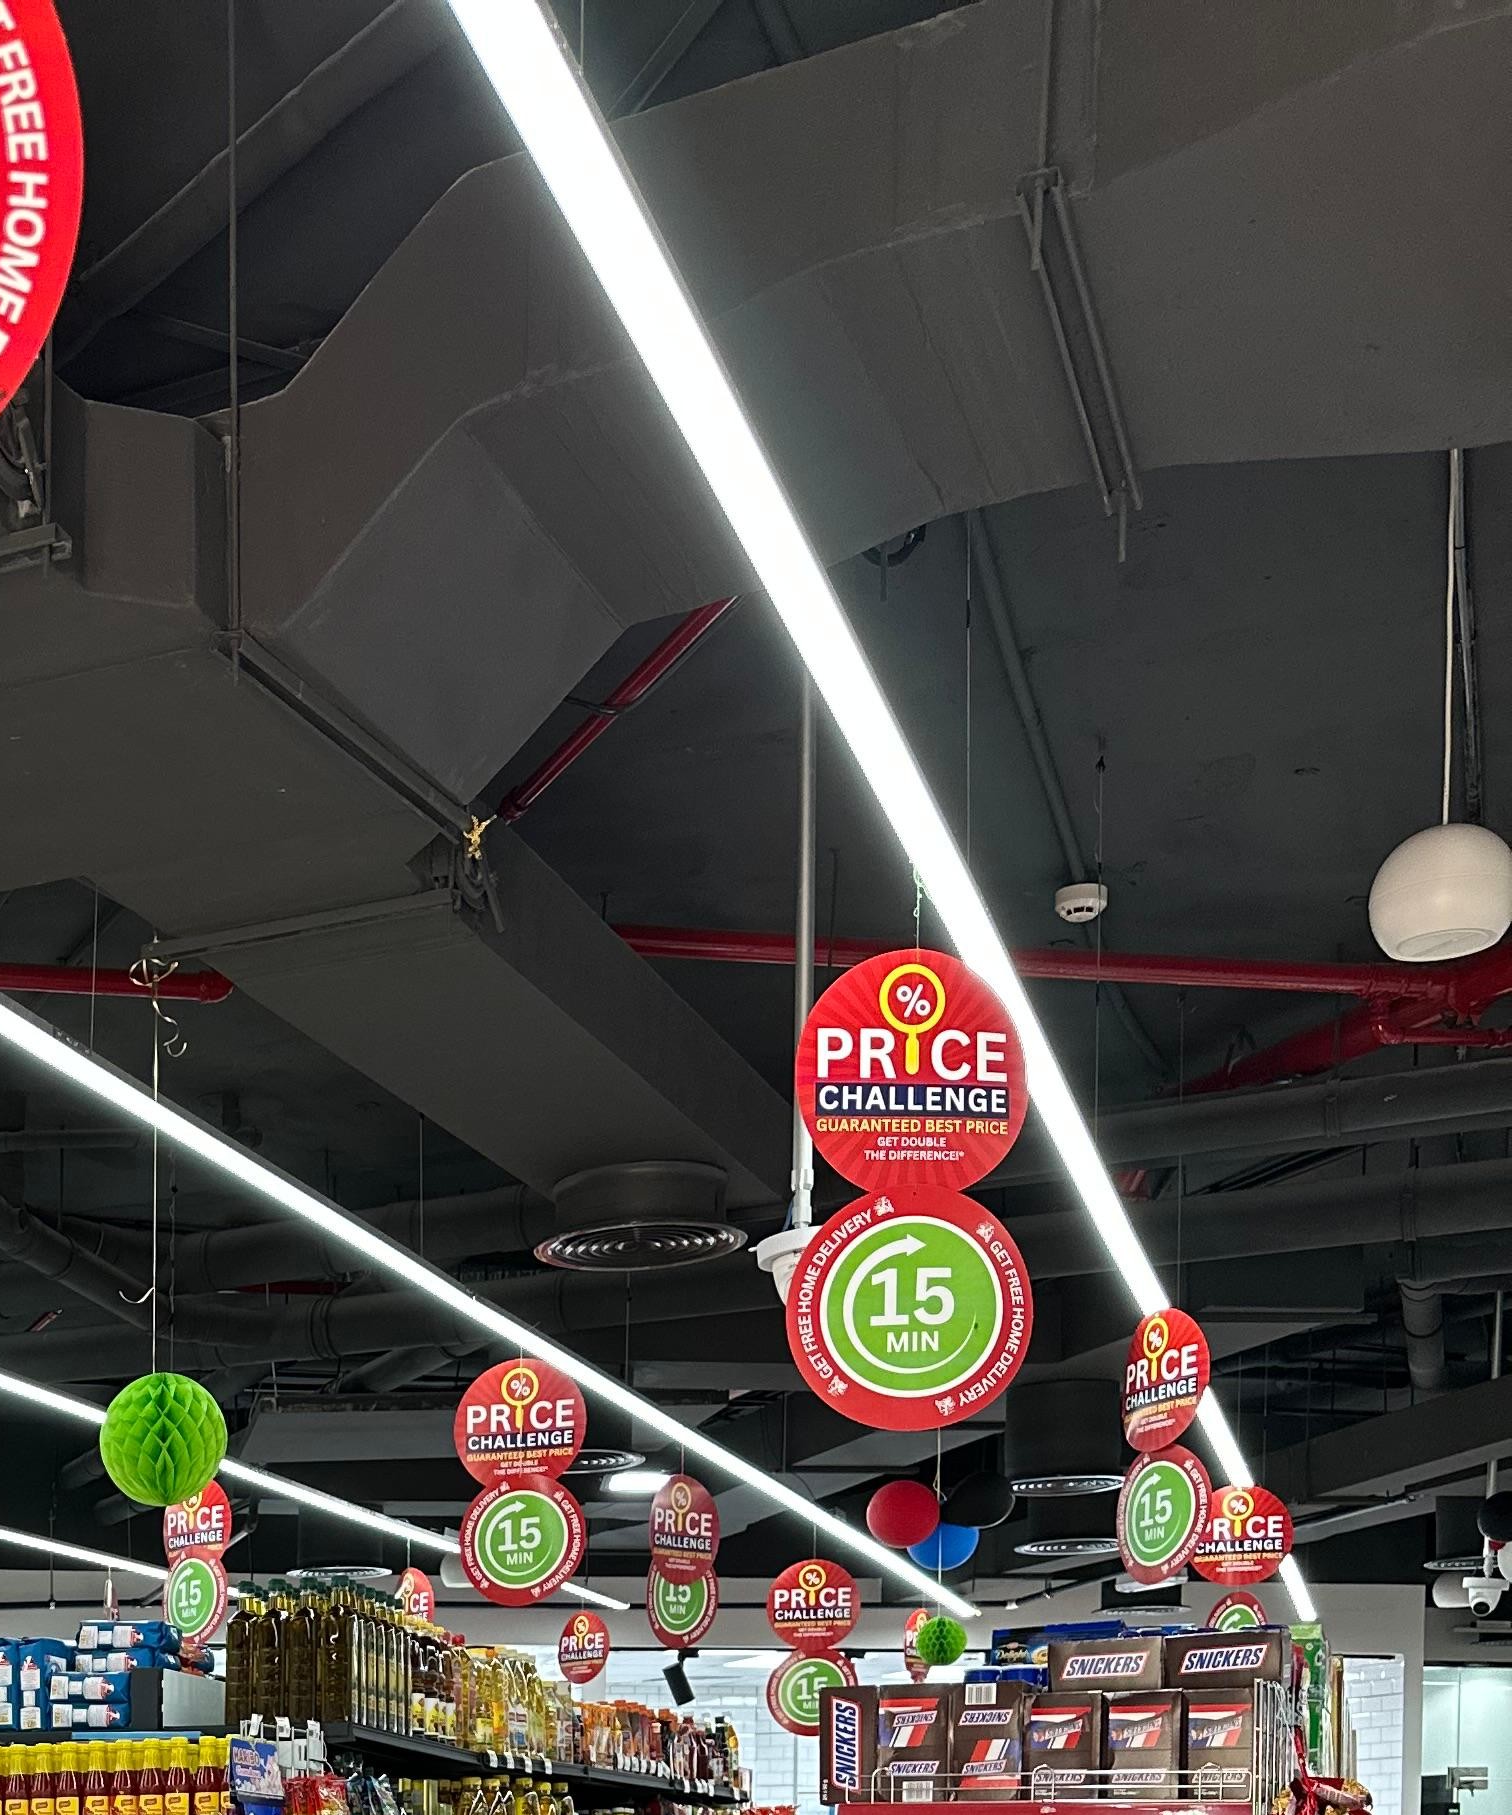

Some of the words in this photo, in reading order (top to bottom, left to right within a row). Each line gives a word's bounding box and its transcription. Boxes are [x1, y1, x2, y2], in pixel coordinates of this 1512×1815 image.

[816, 1028, 1009, 1083] PRICE
[819, 1085, 1008, 1114] CHALLENGE
[816, 1118, 923, 1133] GUARANTEED
[925, 1120, 962, 1134] BEST
[966, 1121, 1009, 1135] PRICE
[877, 1137, 898, 1148] GET
[900, 1137, 947, 1148] DOUBLE
[864, 1150, 886, 1161] THE
[813, 1208, 873, 1266] DELIVERY
[990, 1240, 1013, 1267] GET
[798, 1265, 821, 1313] HOME
[869, 1267, 954, 1326] 15
[1005, 1268, 1024, 1305] FREE
[798, 1315, 818, 1353] FREE
[886, 1331, 939, 1352] MIN
[1005, 1308, 1024, 1354] HOME
[808, 1354, 833, 1379] GET
[1126, 1344, 1199, 1394] PRICE
[959, 1356, 1013, 1407] DELIVERY
[1126, 1377, 1197, 1411] CHALLENGE
[466, 1399, 575, 1434] PRICE
[468, 1430, 573, 1450] CHALLENGE
[548, 1447, 574, 1458] PRICE
[1140, 1489, 1172, 1527] 15
[168, 1504, 225, 1536] PRICE
[654, 1508, 713, 1536] PRICE
[168, 1530, 223, 1549] CHALLENGE
[498, 1516, 541, 1551] 15
[655, 1535, 711, 1550] CHALLENGE
[1145, 1526, 1165, 1541] MIN
[507, 1552, 533, 1565] MIN
[178, 1579, 202, 1607] 15
[774, 1587, 852, 1609] PRICE
[669, 1604, 686, 1615] MIN
[775, 1608, 851, 1621] CHALLENGE
[561, 1632, 605, 1650] PRICE
[1066, 1656, 1144, 1676] SNICKERS
[1186, 1648, 1263, 1670] SNICKERS
[896, 1712, 935, 1724] SNICKERS
[962, 1711, 1010, 1724] SNICKERS
[836, 1702, 857, 1788] SNICKERS
[891, 1762, 937, 1774] SNICKERS
[964, 1761, 1004, 1773] SNICKERS
